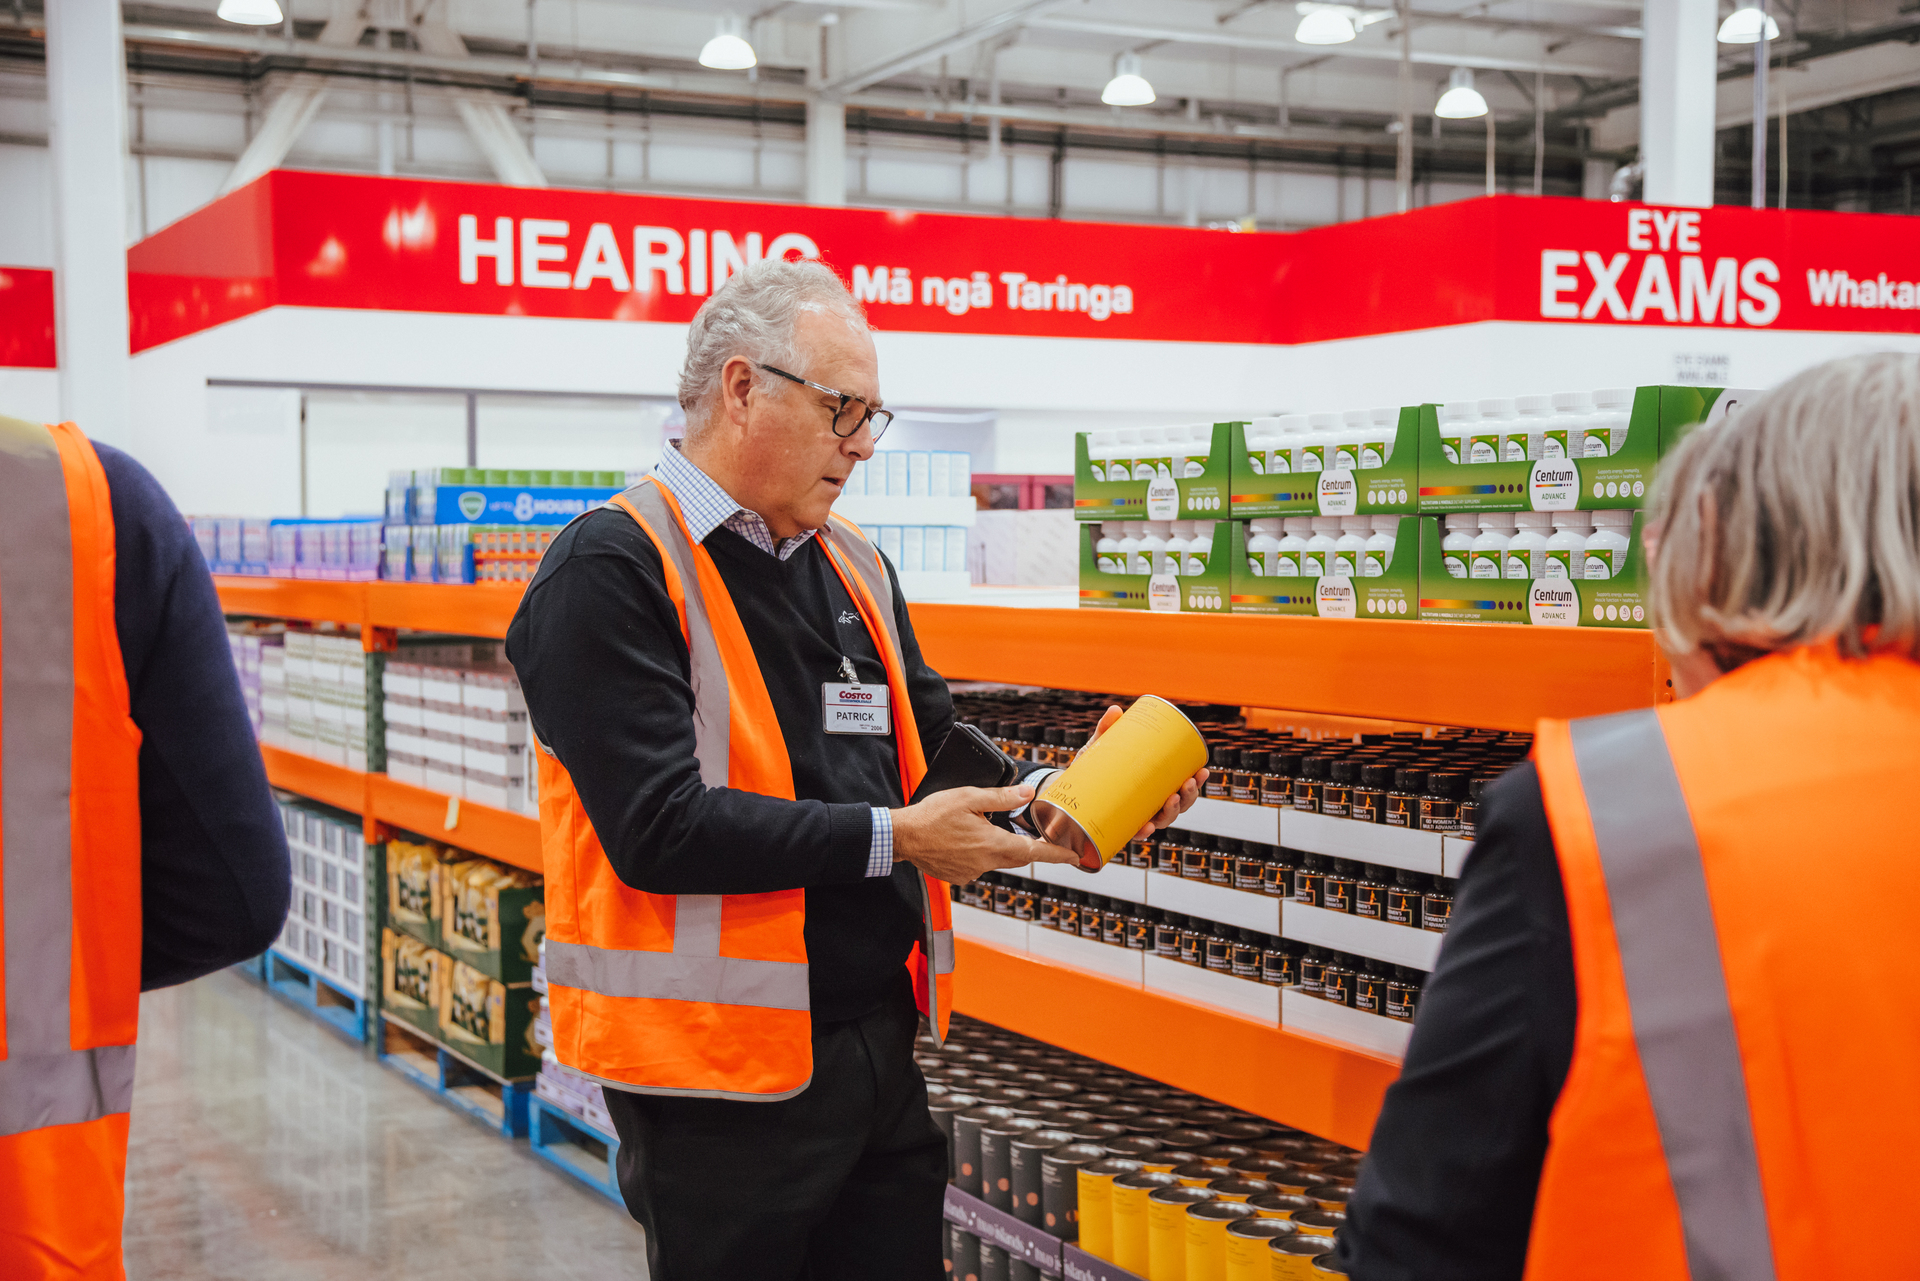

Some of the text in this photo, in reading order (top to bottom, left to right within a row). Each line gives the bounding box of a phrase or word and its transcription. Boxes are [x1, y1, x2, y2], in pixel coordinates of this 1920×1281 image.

[1628, 208, 1701, 253] EYE
[852, 264, 1134, 321] Mā ngā Taringa
[1540, 249, 1781, 326] EXAMS
[1535, 469, 1573, 482] Centrum
[1321, 479, 1352, 491] Centrum
[1541, 492, 1567, 500] ADVANCE
[513, 492, 535, 522] 8
[533, 499, 585, 514] HOURS
[1319, 585, 1351, 597] Centrum
[1534, 589, 1573, 602] Centrum
[1541, 612, 1567, 620] ADVANCE
[836, 712, 875, 722] PATRICK
